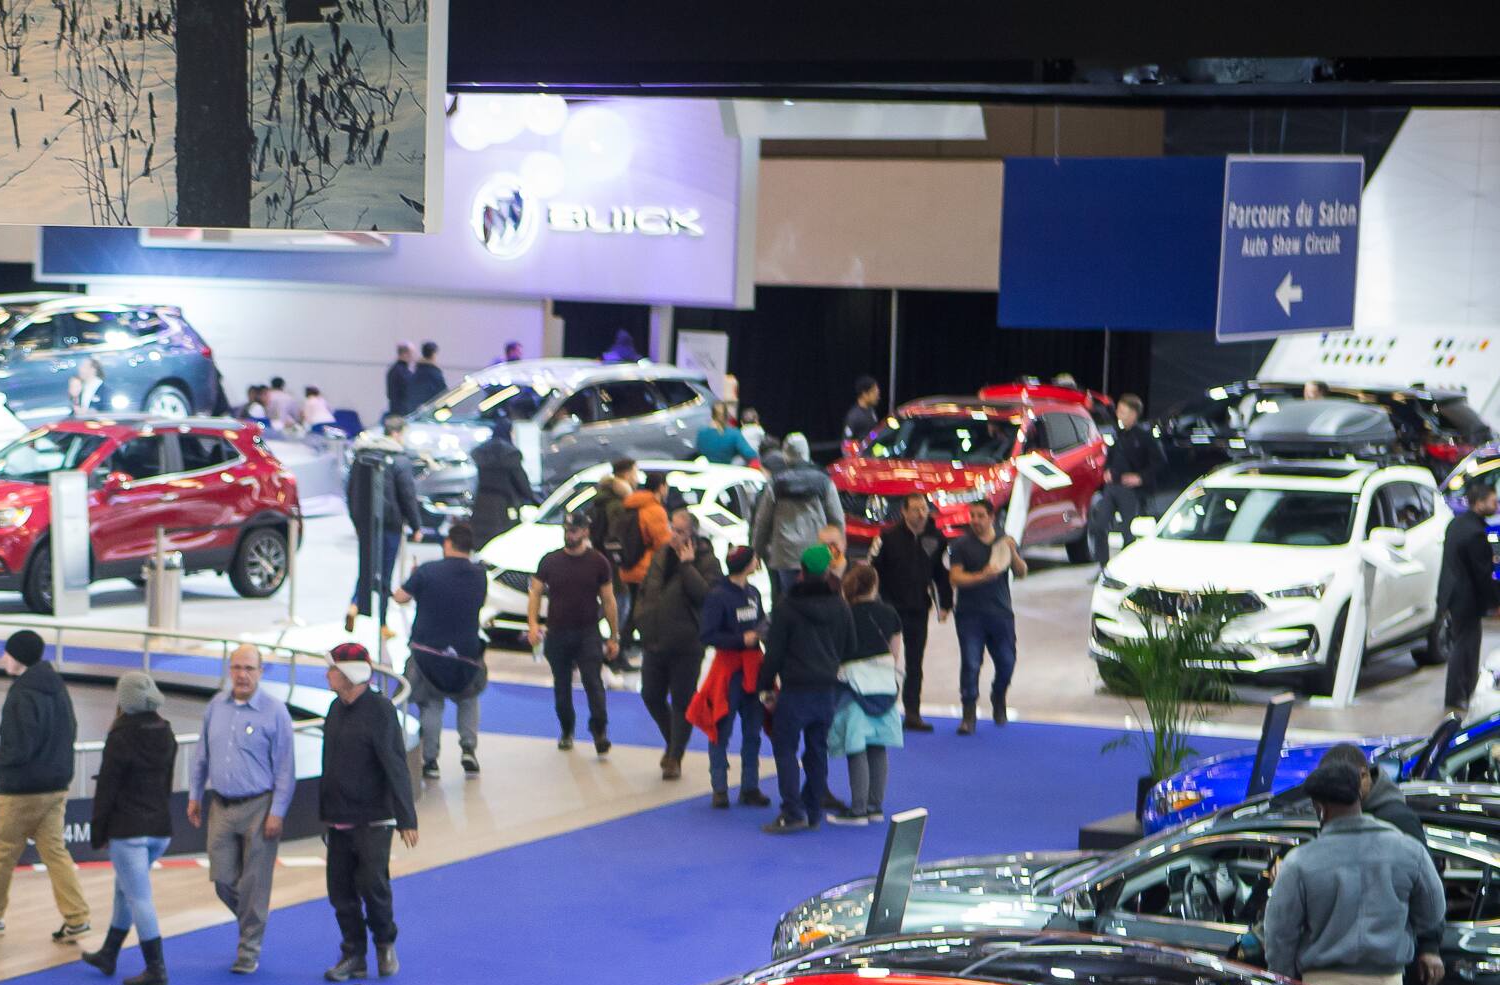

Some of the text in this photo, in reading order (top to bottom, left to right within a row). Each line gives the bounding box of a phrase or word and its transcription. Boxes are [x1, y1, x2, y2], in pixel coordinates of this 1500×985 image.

[548, 203, 705, 236] BUICK
[1228, 198, 1357, 229] Parcours du Salon
[1241, 231, 1340, 257] Auto Show Circuit
